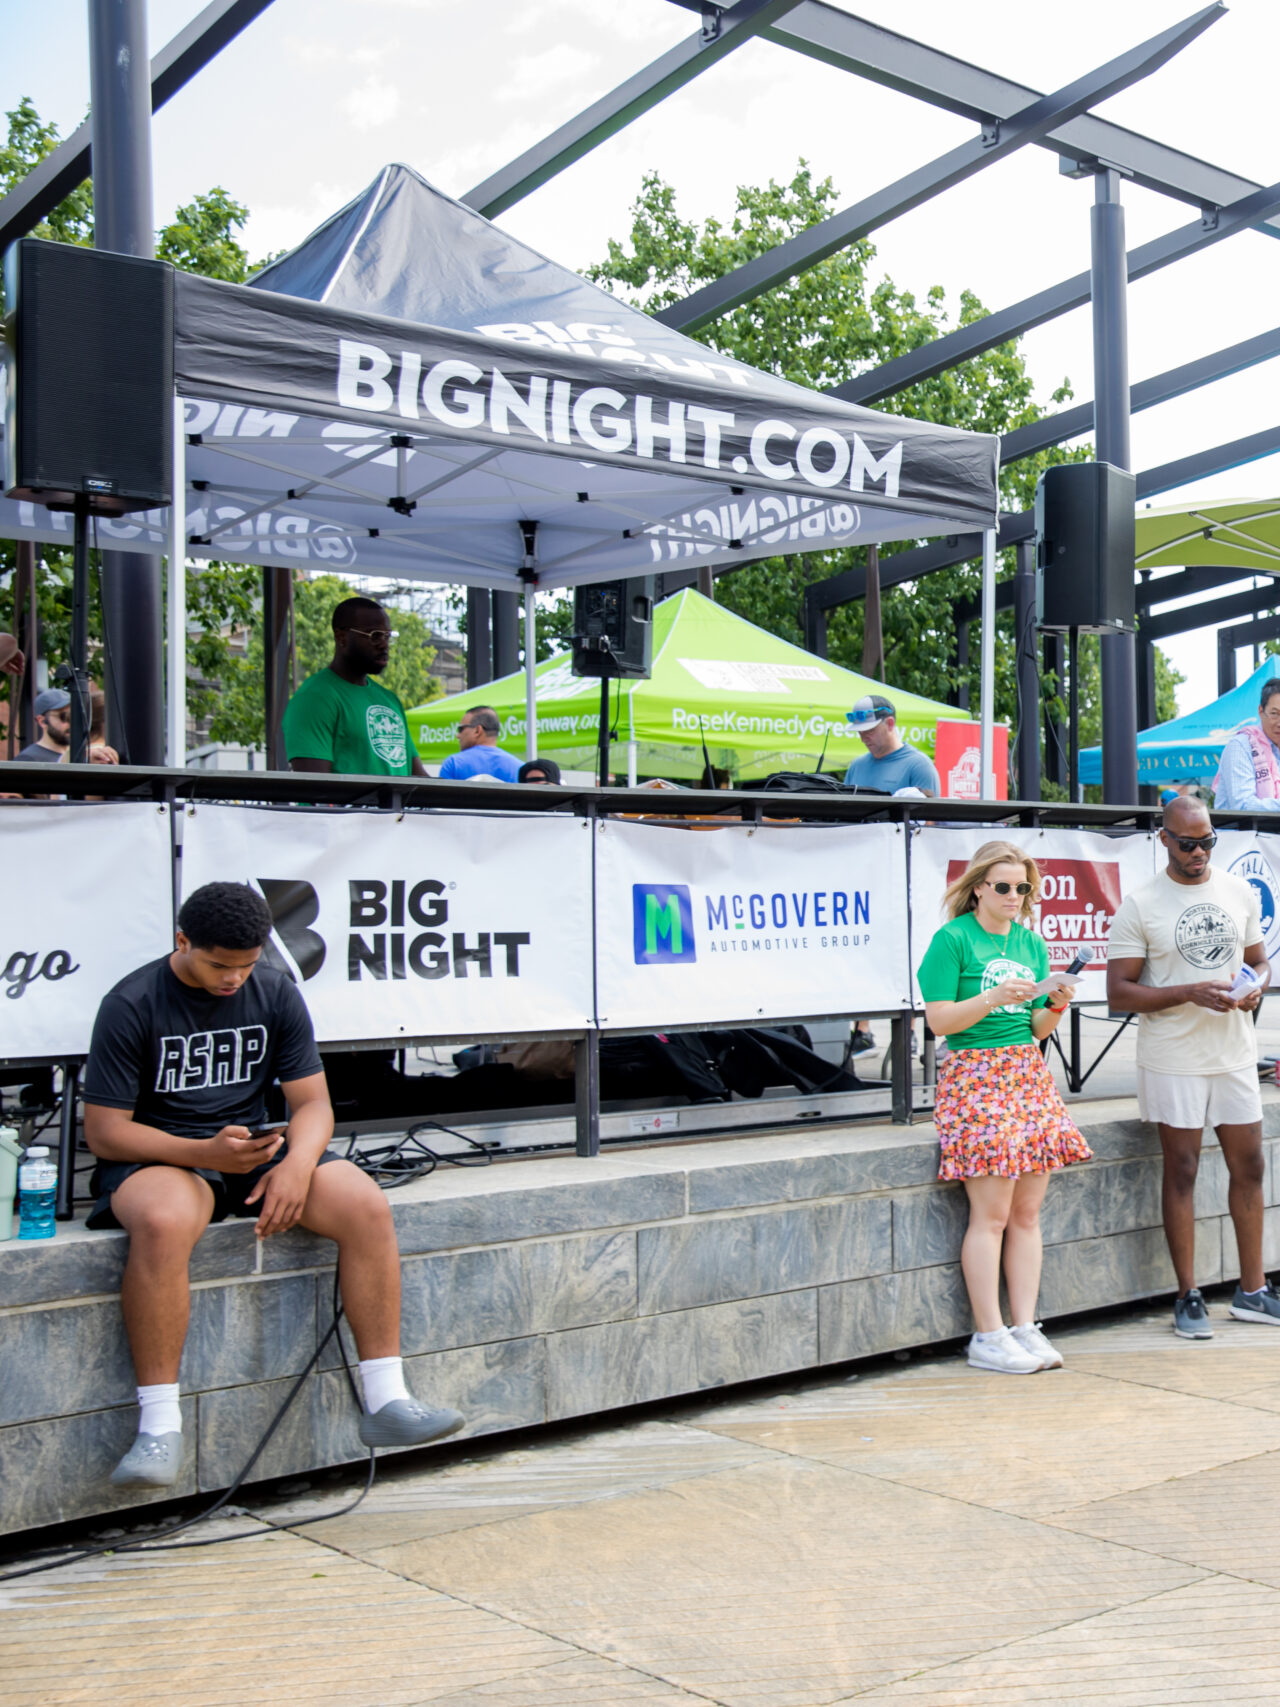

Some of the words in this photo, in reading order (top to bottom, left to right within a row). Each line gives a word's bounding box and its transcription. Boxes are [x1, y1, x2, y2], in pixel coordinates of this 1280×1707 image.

[337, 338, 904, 498] BIGNIGHT.COM
[672, 708, 937, 748] RoseKennedyGreey.org
[1241, 857, 1264, 878] TALL
[349, 879, 449, 927] BIG
[348, 931, 531, 981] NIGHT
[710, 936, 809, 953] AUTOMOTIVE
[821, 934, 872, 948] GROUP
[154, 1024, 269, 1094] ASAP
